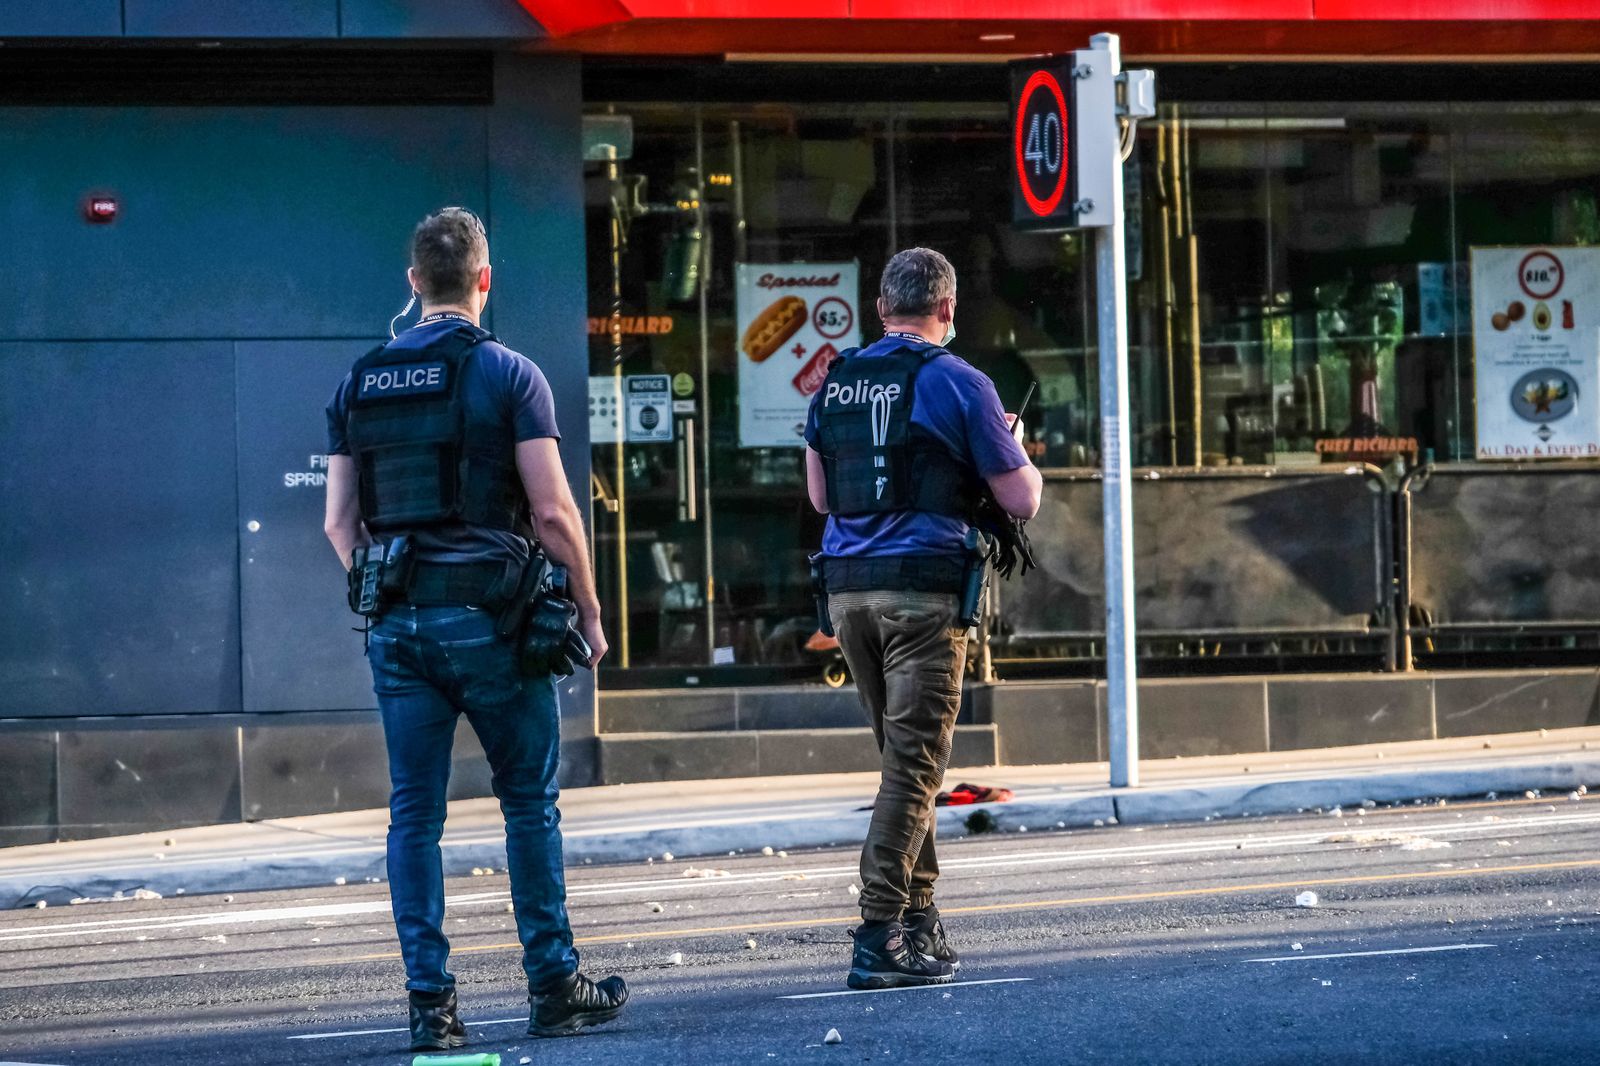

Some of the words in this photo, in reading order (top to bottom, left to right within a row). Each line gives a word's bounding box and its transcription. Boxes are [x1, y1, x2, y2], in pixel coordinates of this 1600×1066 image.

[1025, 112, 1060, 175] 40
[94, 202, 115, 211] FIRE
[756, 273, 840, 290] Special
[363, 367, 441, 392] POLICE
[631, 379, 665, 390] NOTICE
[824, 379, 900, 408] Police
[1353, 436, 1418, 452] RICHARD
[1504, 444, 1529, 455] DAY
[1547, 443, 1584, 455] EVERY
[1587, 442, 1600, 454] D
